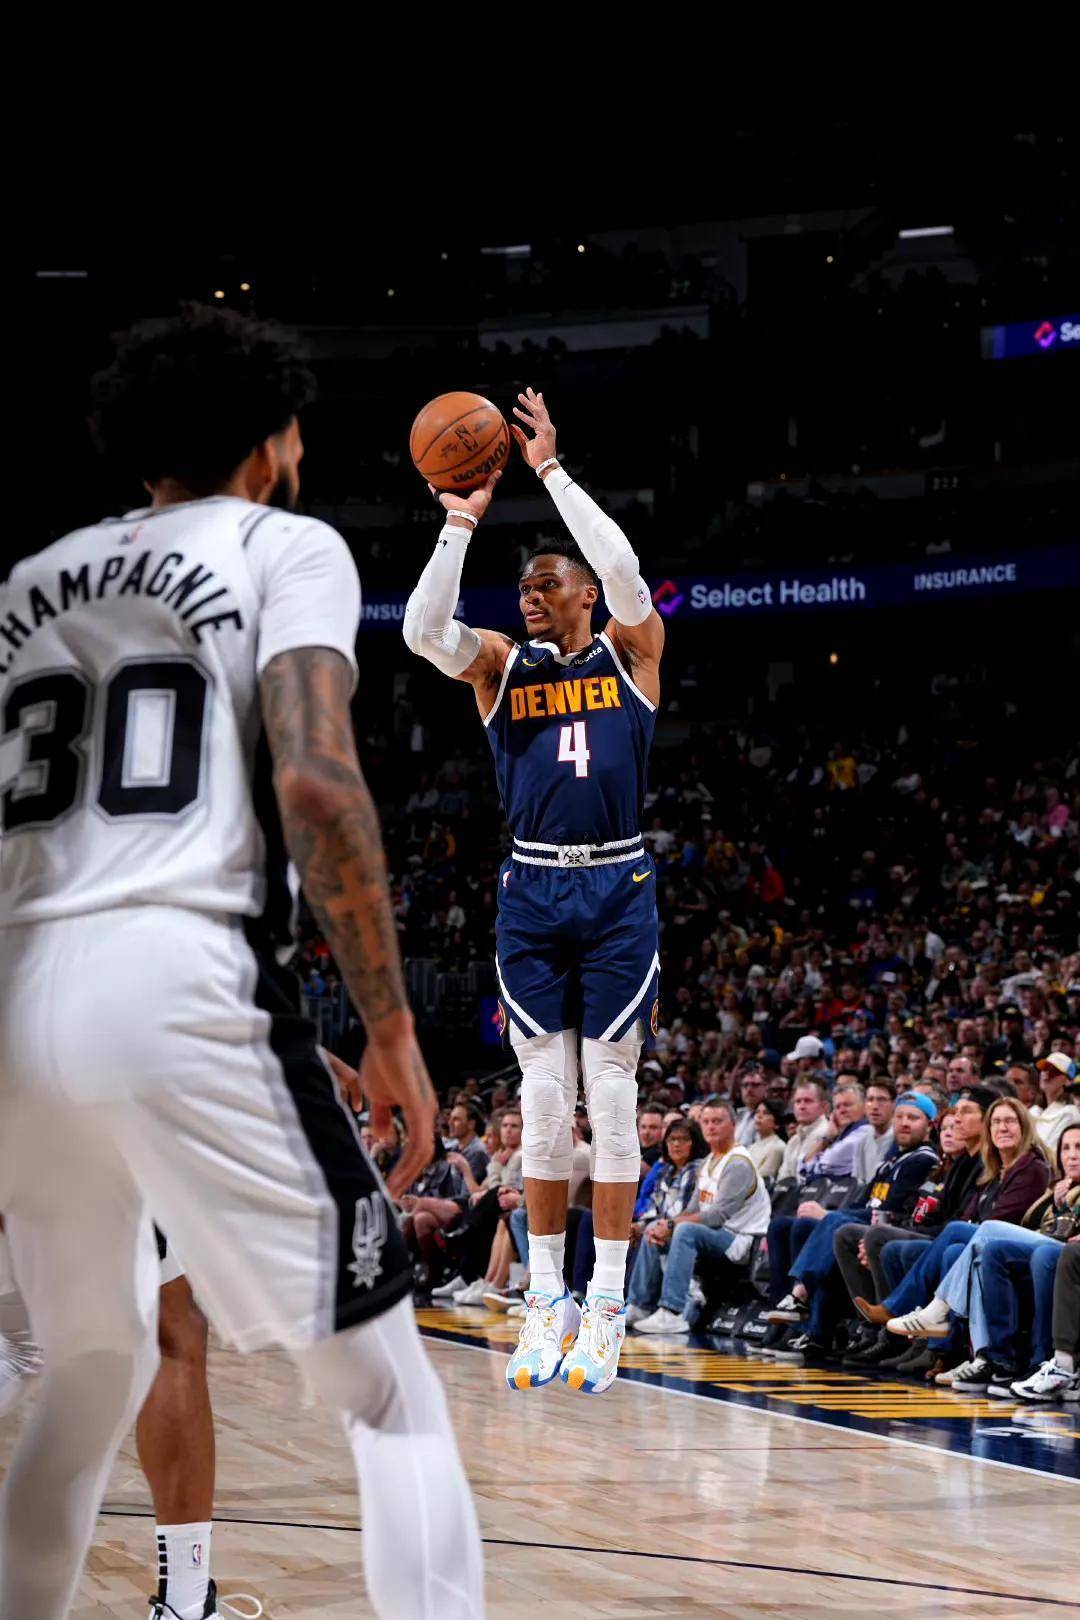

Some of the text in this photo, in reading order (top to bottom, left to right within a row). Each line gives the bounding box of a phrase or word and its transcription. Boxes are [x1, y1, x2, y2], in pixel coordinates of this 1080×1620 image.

[690, 577, 866, 609] Select Health
[914, 563, 1016, 591] INSURANCE
[511, 677, 620, 720] DENVER
[0, 655, 214, 834] 30
[557, 721, 590, 777] 4
